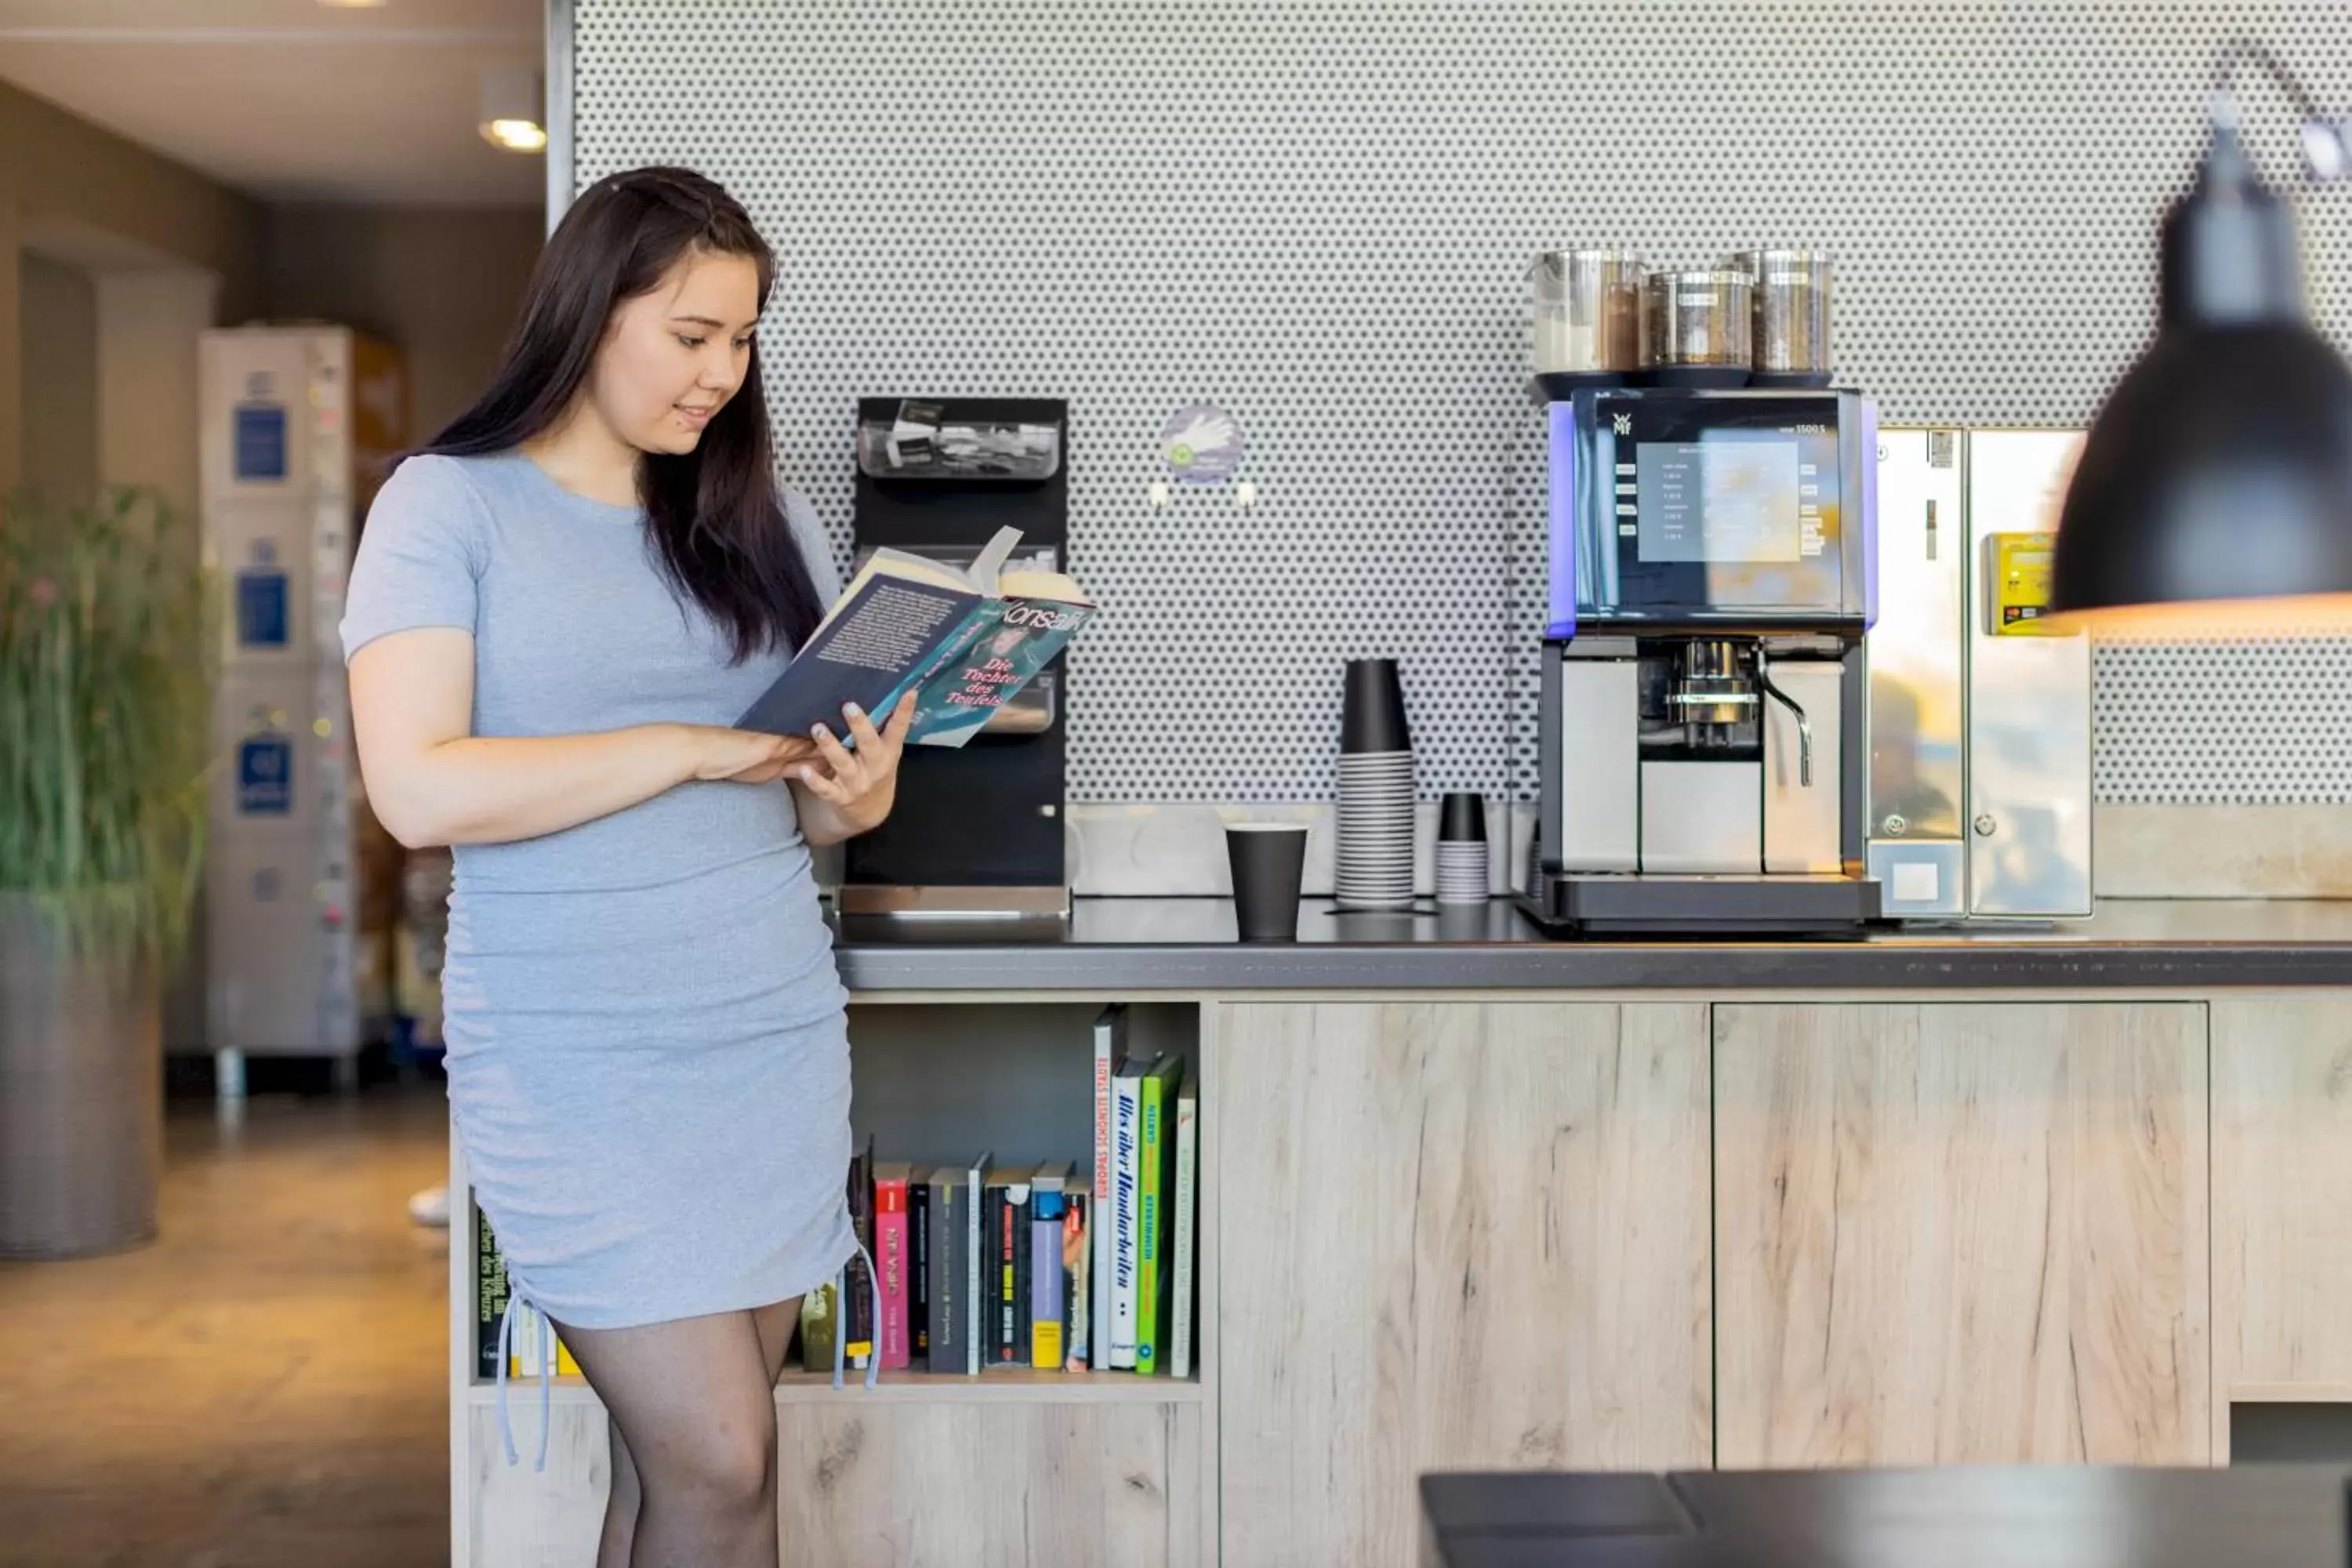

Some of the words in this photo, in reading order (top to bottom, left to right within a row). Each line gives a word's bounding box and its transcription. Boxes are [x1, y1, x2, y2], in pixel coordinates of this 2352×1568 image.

[983, 658, 1014, 671] Die
[960, 668, 1022, 684] Tochter
[965, 682, 995, 695] des
[945, 692, 1004, 706] Teufels
[1118, 1089, 1134, 1127] Alles
[1118, 1130, 1134, 1170] über
[1117, 1171, 1134, 1288] Handarbeiten
